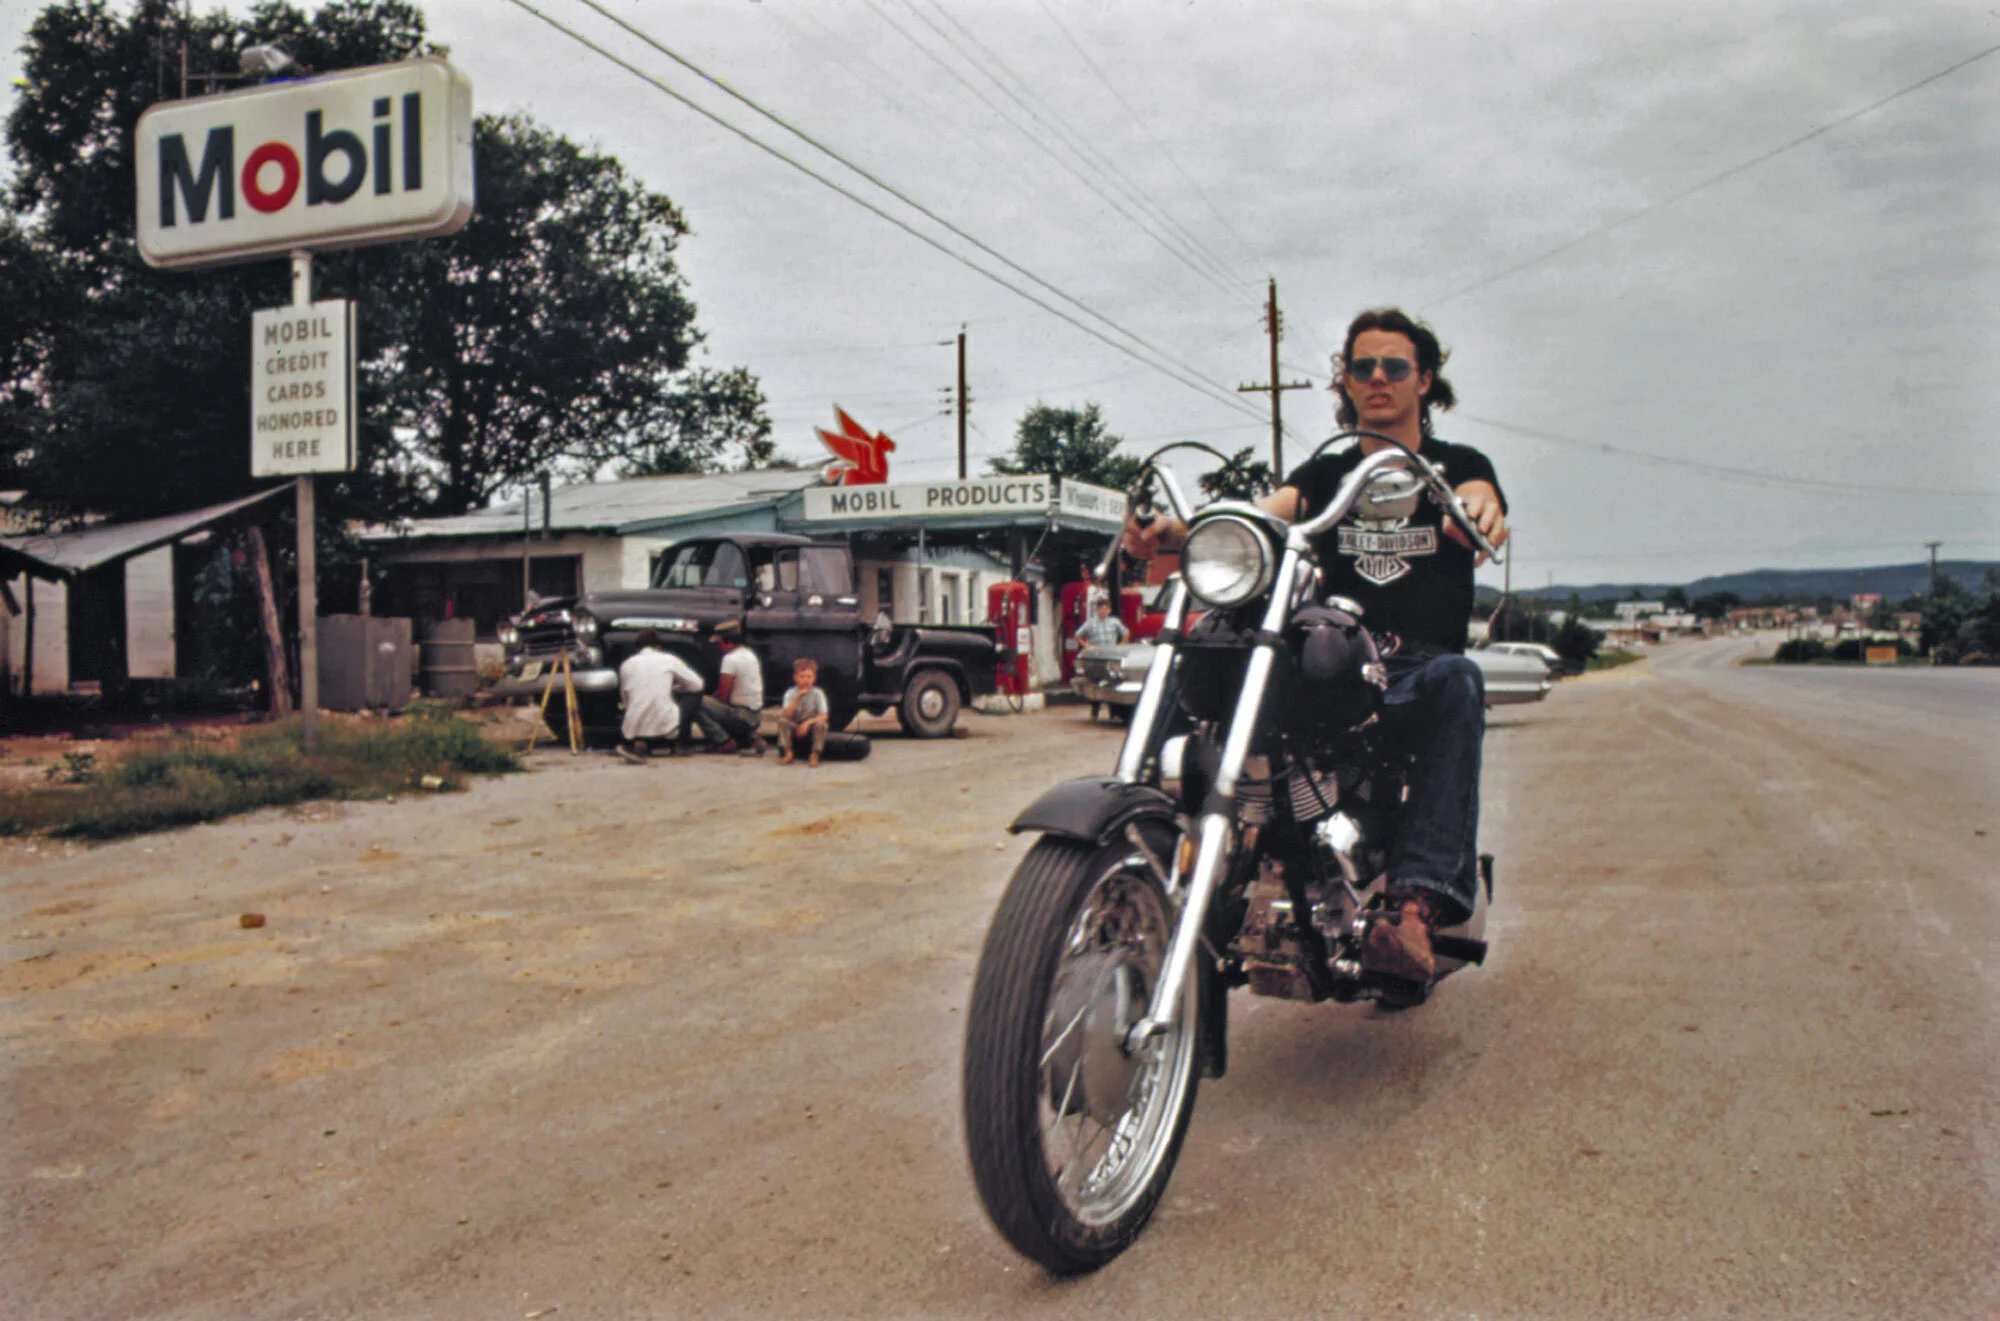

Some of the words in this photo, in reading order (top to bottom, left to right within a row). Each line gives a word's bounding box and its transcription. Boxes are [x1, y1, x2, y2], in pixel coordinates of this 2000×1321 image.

[158, 92, 422, 228] Mobil
[264, 317, 332, 346] MOBIL
[265, 351, 329, 375] CREDIT
[267, 380, 326, 403] CARDS
[256, 409, 338, 432] HONORED
[272, 439, 321, 459] HERE
[831, 490, 900, 514] MOBIL
[926, 483, 1045, 508] PRODUCTS
